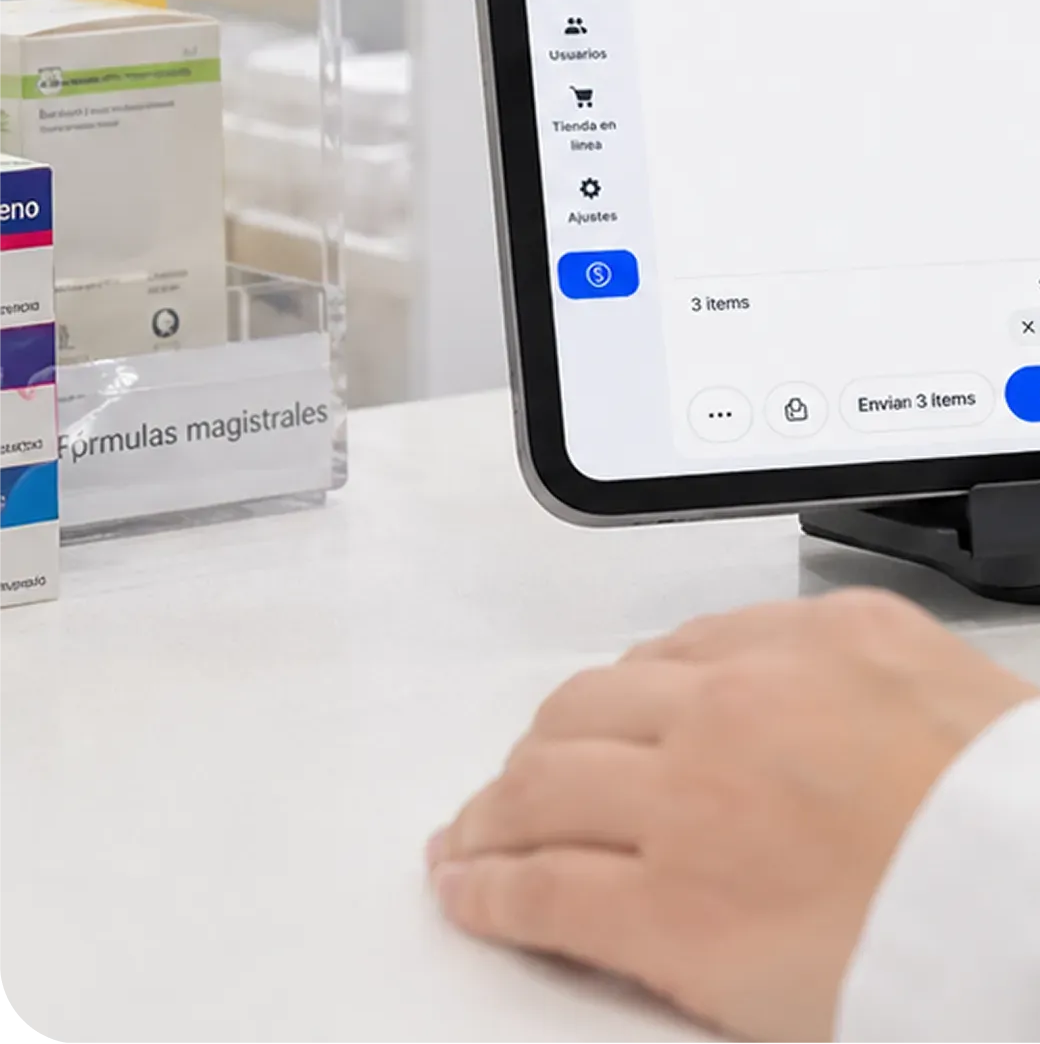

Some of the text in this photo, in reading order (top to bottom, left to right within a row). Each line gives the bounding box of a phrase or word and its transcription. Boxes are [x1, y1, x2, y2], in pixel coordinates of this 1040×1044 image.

[548, 46, 608, 62] Usuarios
[551, 119, 617, 133] Tienda en
[567, 210, 618, 225] Ajustes
[690, 295, 751, 312] 3 items
[915, 393, 928, 409] 3
[57, 423, 178, 463] Fórmulas
[186, 401, 329, 443] magistrales
